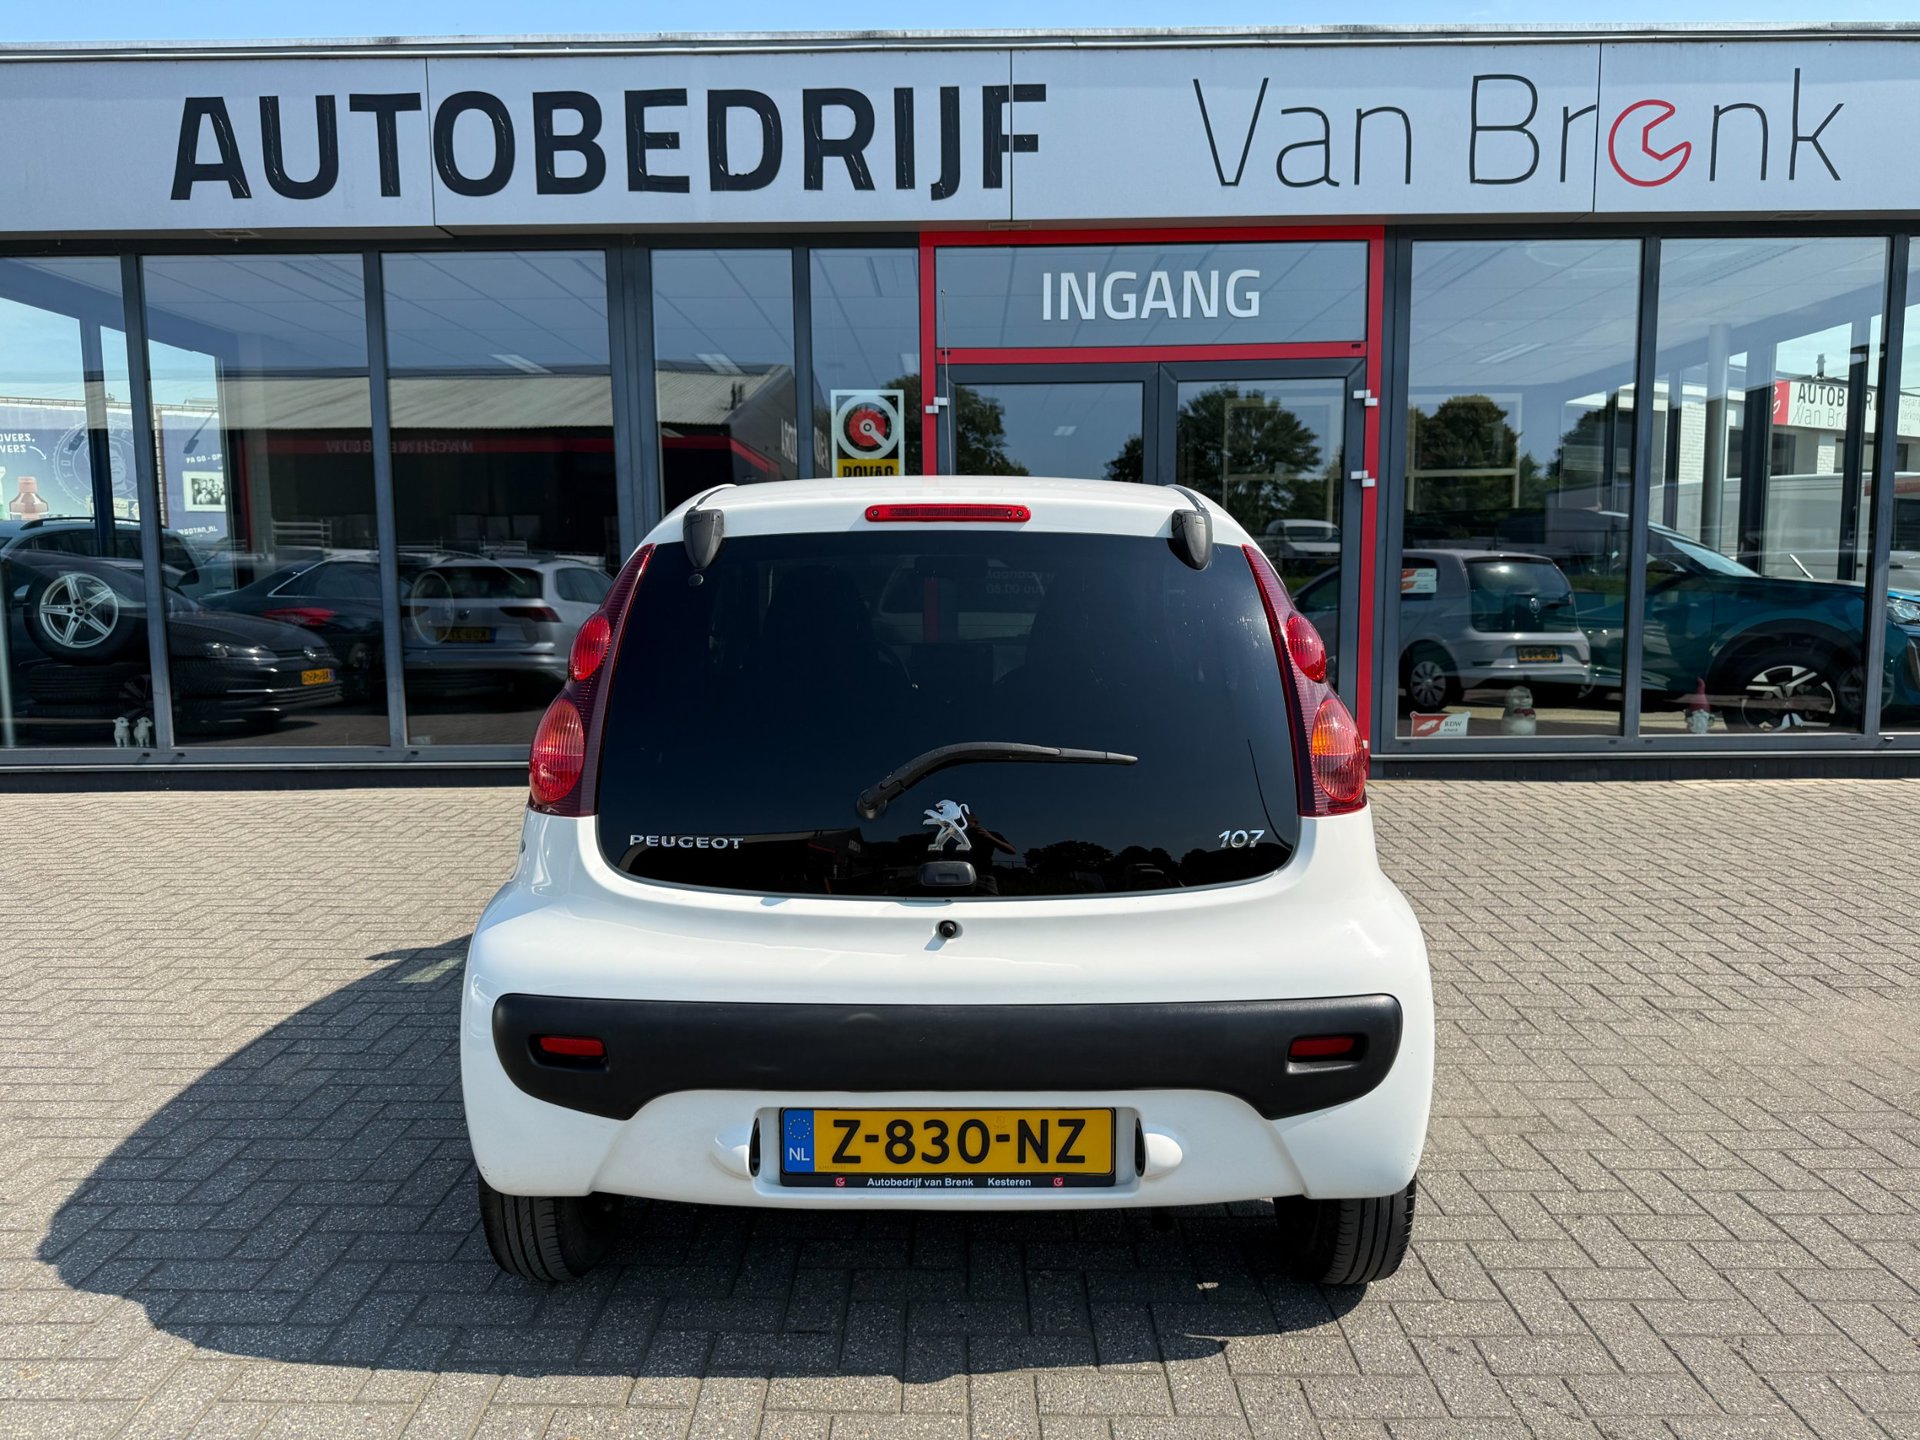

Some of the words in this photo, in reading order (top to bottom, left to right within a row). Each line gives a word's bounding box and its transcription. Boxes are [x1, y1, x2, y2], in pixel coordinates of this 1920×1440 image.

[170, 83, 1047, 201] AUTOBEDRIJF
[1193, 77, 1412, 188] Van
[1042, 269, 1261, 321] INGANG
[629, 834, 744, 850] PEUGEOT
[1218, 829, 1265, 849] 107
[832, 1118, 1087, 1165] Z-830-NZ
[788, 1147, 811, 1162] NL
[866, 1177, 922, 1188] Autobedrijf
[924, 1179, 943, 1188] van
[944, 1177, 974, 1187] Brenk
[987, 1177, 1032, 1187] Kesteren
